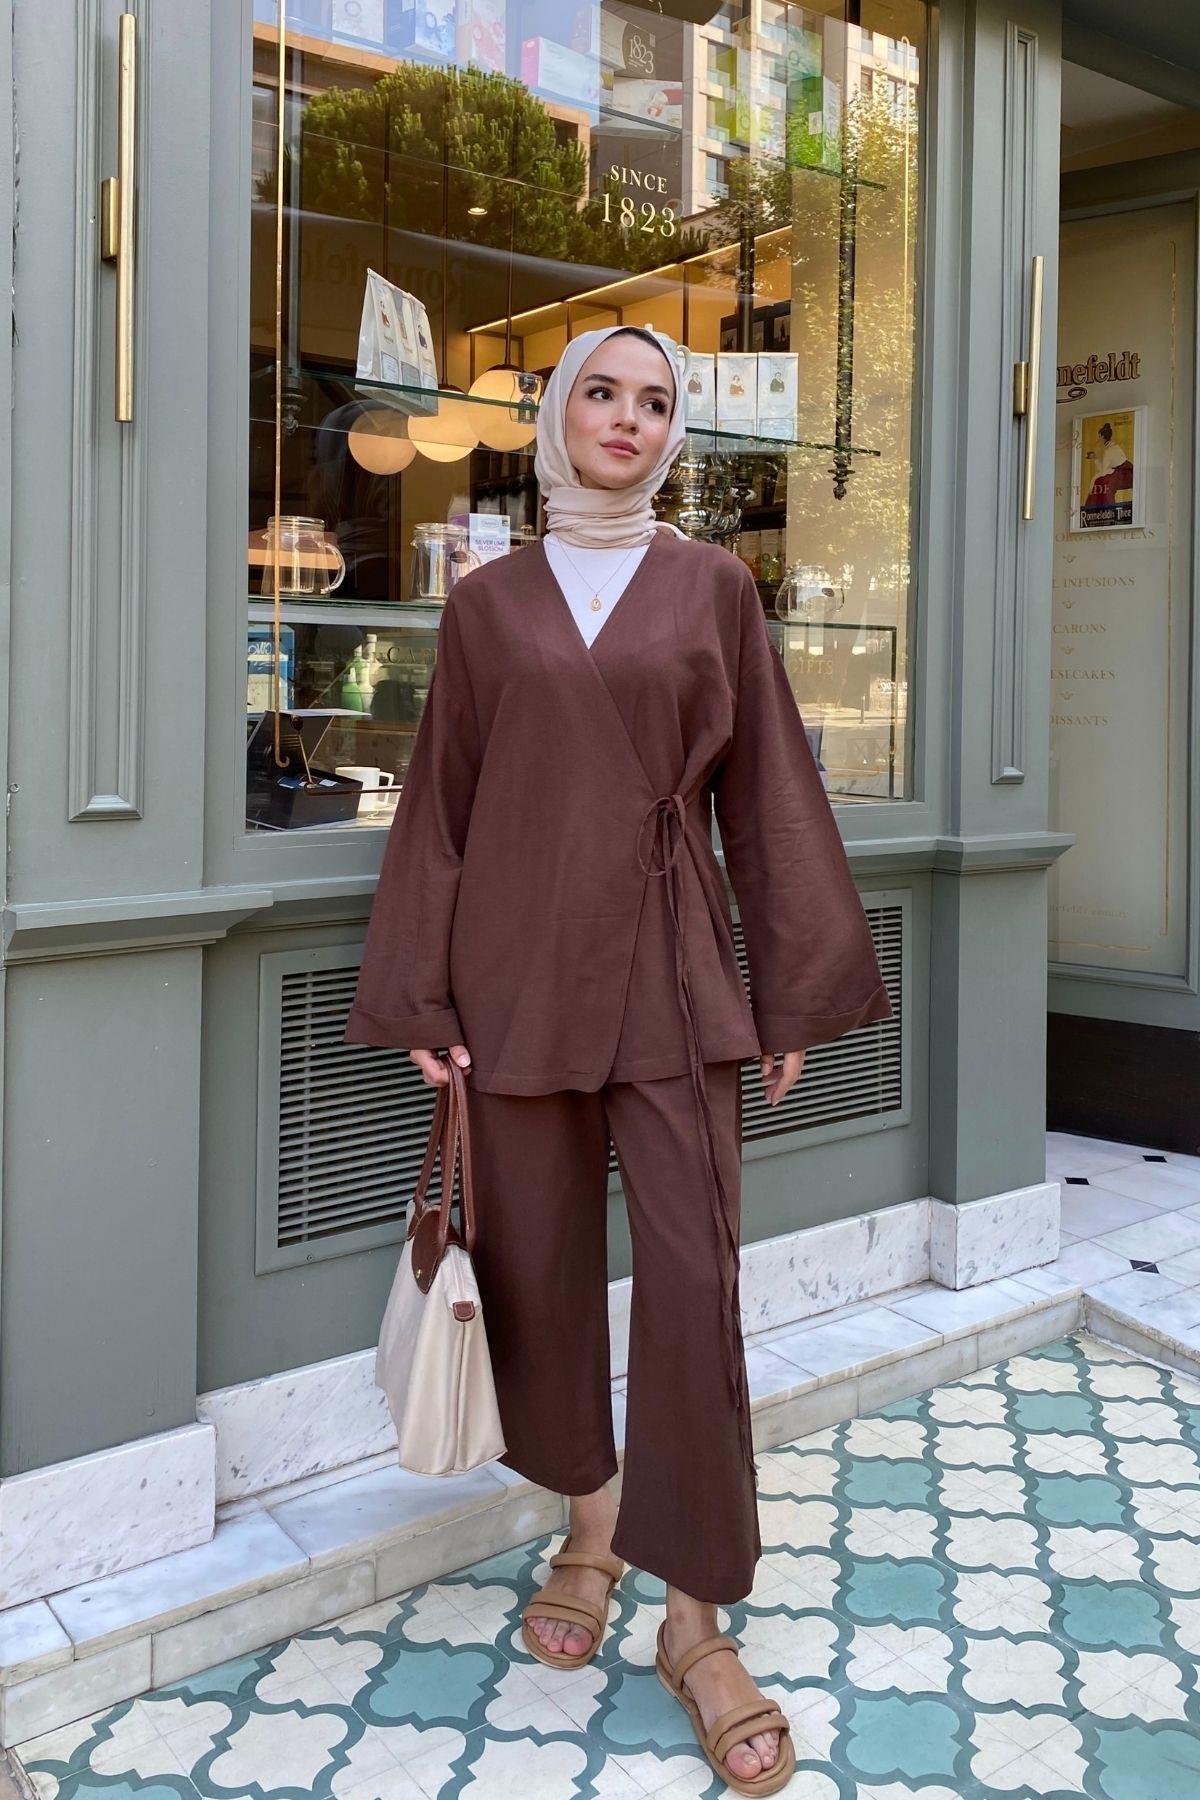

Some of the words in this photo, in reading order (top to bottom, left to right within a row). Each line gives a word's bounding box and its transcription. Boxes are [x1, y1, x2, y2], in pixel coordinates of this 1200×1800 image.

[630, 35, 654, 73] 1823
[610, 164, 667, 194] SINCE
[602, 193, 675, 237] 1823
[1057, 351, 1141, 387] nefeldt
[1121, 528, 1155, 540] TEAS
[1063, 576, 1136, 588] INFUSIONS
[789, 657, 834, 675] GIFTS
